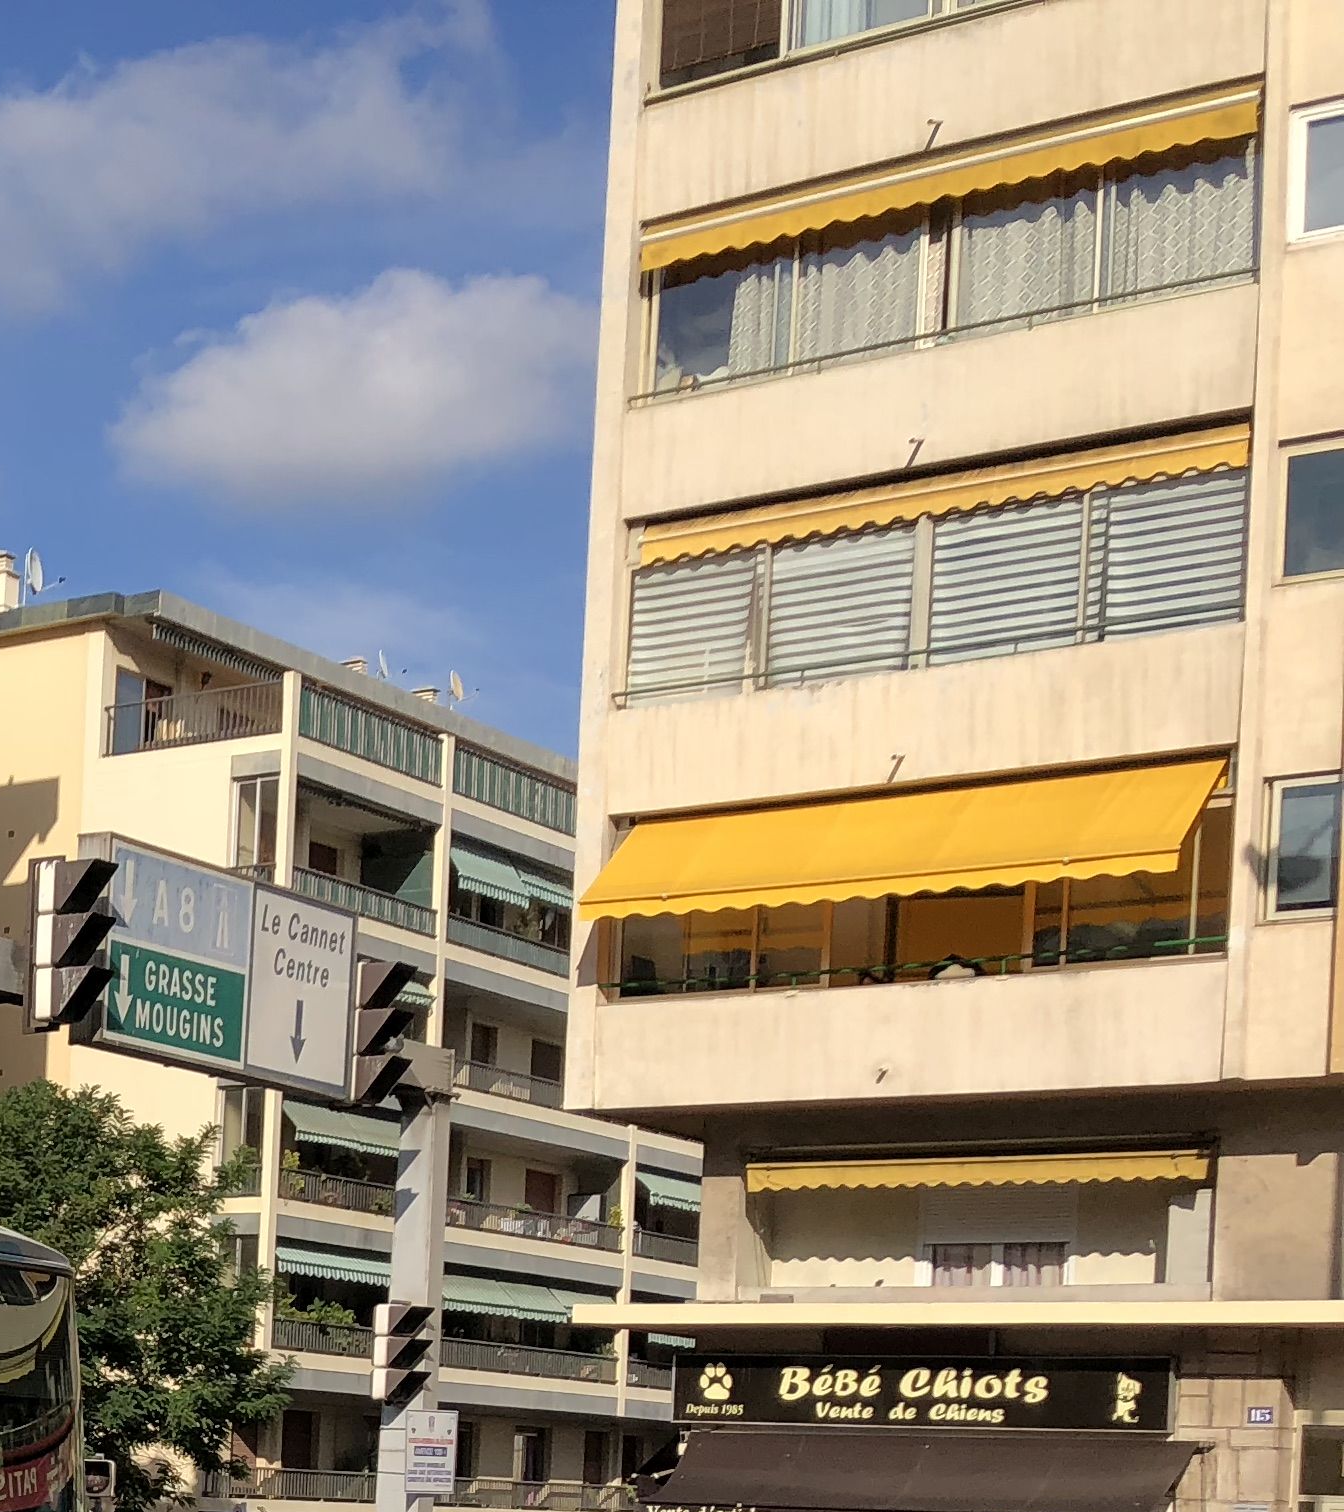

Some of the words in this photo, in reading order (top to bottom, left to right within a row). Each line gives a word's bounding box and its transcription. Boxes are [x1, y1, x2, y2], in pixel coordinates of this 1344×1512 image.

[261, 904, 281, 935] Le
[288, 912, 346, 955] Cannet
[145, 960, 217, 1007] GRASSE
[274, 948, 330, 988] Centre
[135, 998, 224, 1048] MOUGINS
[778, 1364, 882, 1400] BéBé
[899, 1367, 1049, 1404] Chiots
[685, 1403, 719, 1417] Depuis
[720, 1404, 744, 1416] 1985
[815, 1401, 874, 1420] Vente
[888, 1402, 918, 1421] de
[928, 1403, 1005, 1424] Chiens
